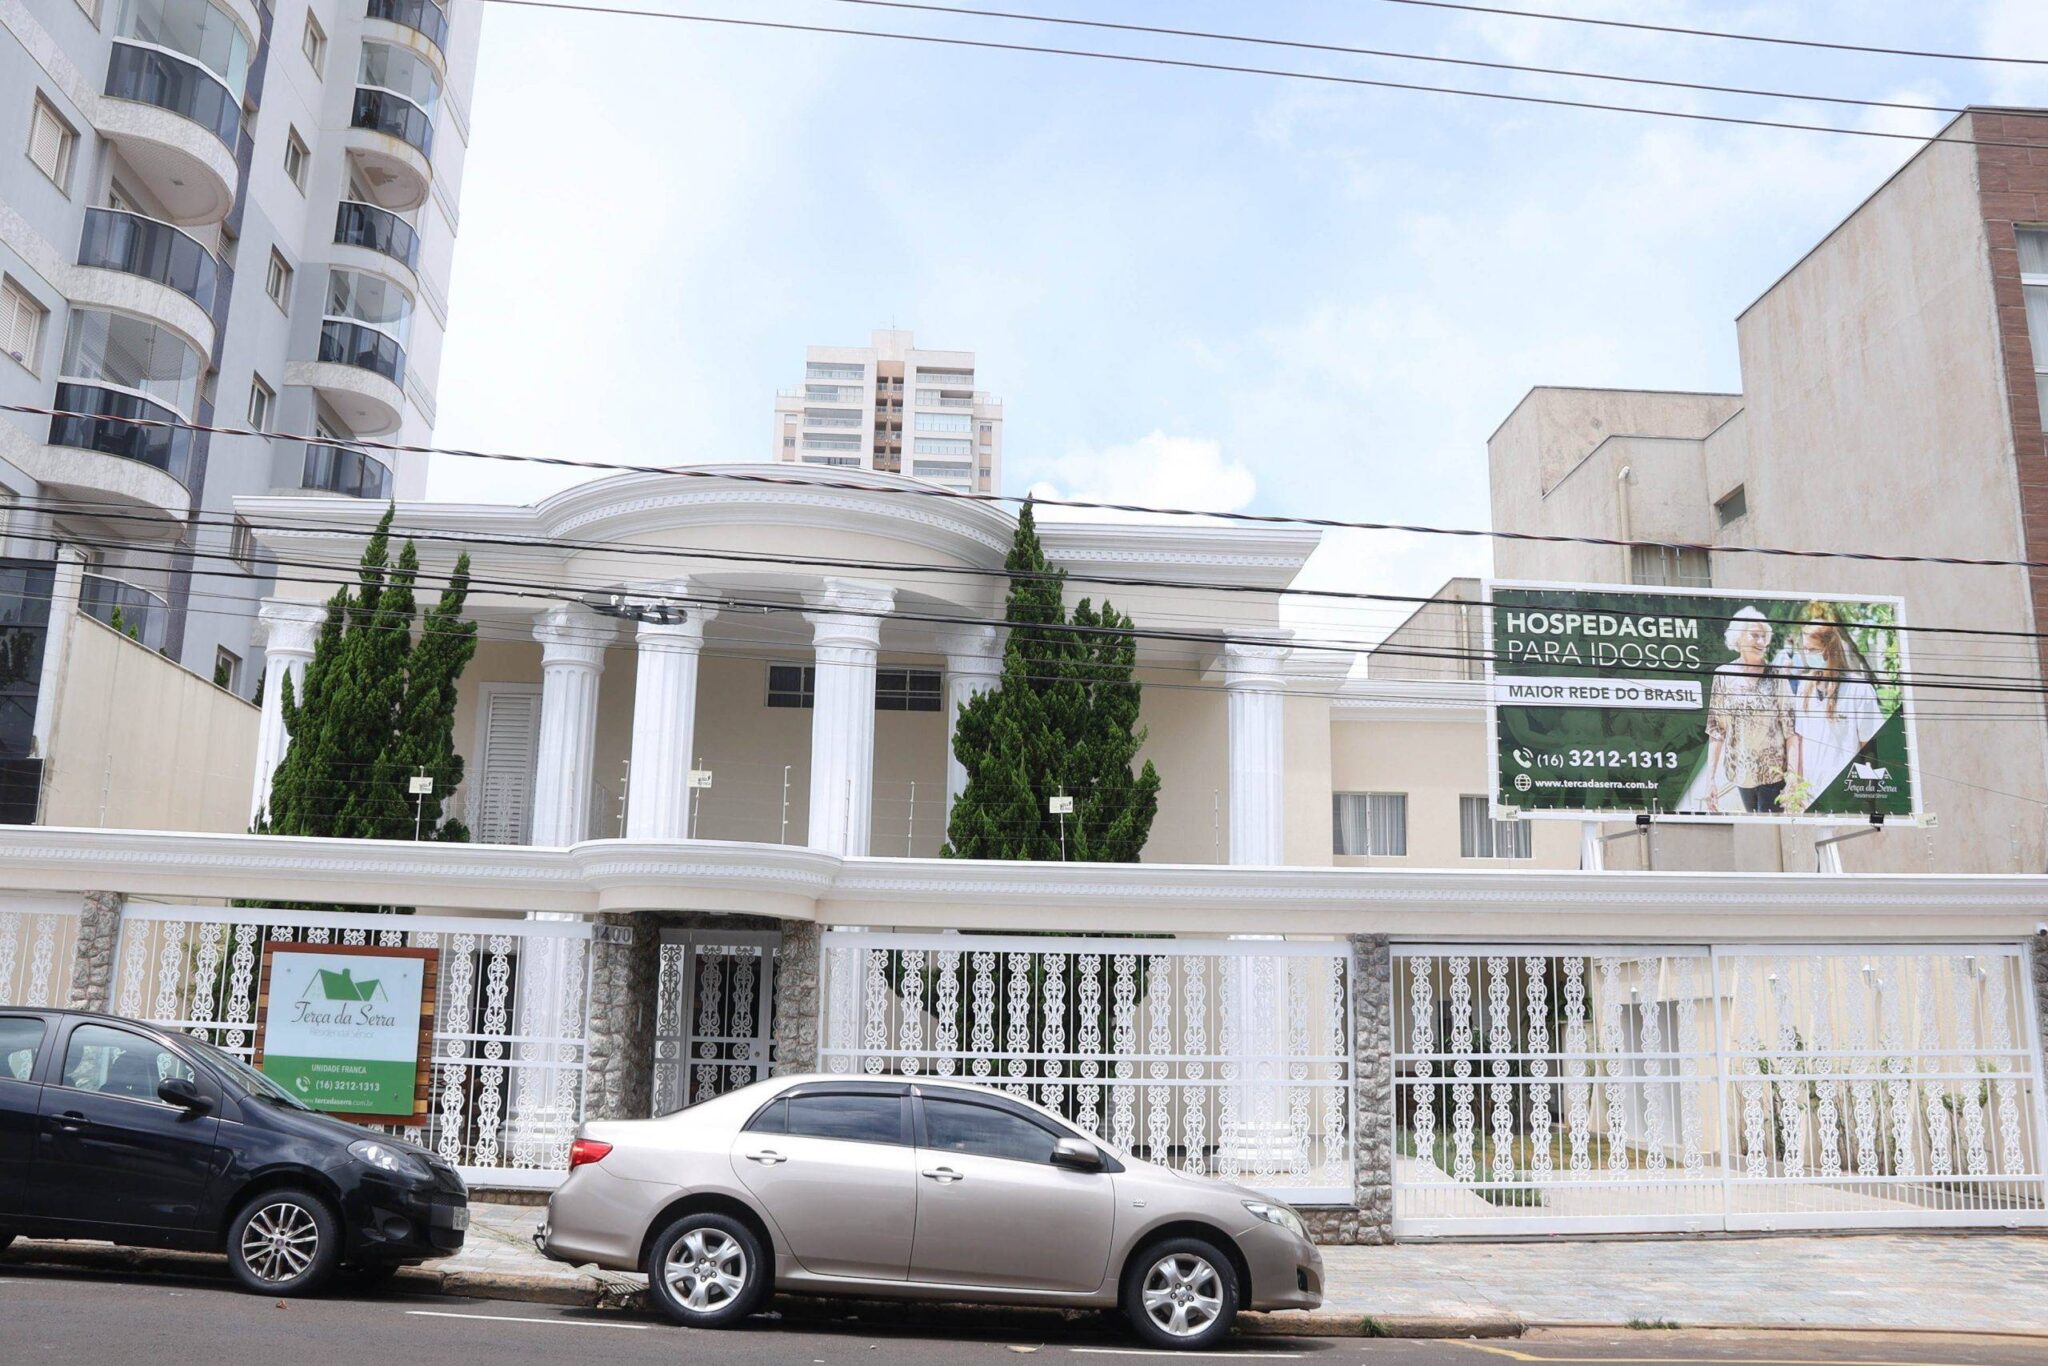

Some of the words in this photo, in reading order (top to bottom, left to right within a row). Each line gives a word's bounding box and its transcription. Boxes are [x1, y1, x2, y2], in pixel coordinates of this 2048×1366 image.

[1506, 612, 1699, 639] HOSPEDAGEM
[1508, 640, 1583, 664] PARA
[1590, 642, 1701, 669] IDOSOS
[1508, 685, 1564, 699] MAIOR
[1569, 687, 1610, 700] REDE
[1615, 688, 1640, 701] DO
[1645, 689, 1697, 702] BRASIL
[1537, 754, 1564, 768] (16)
[1568, 750, 1678, 769] 3212-1313
[1535, 779, 1659, 790] www.tercadaserra.com.br
[291, 1000, 332, 1026] Terça
[334, 1002, 353, 1025] da
[355, 1003, 396, 1027] Serra
[311, 1064, 340, 1073] UNIDADE
[315, 1080, 333, 1091] (16)
[334, 1081, 380, 1092] 3212-1313
